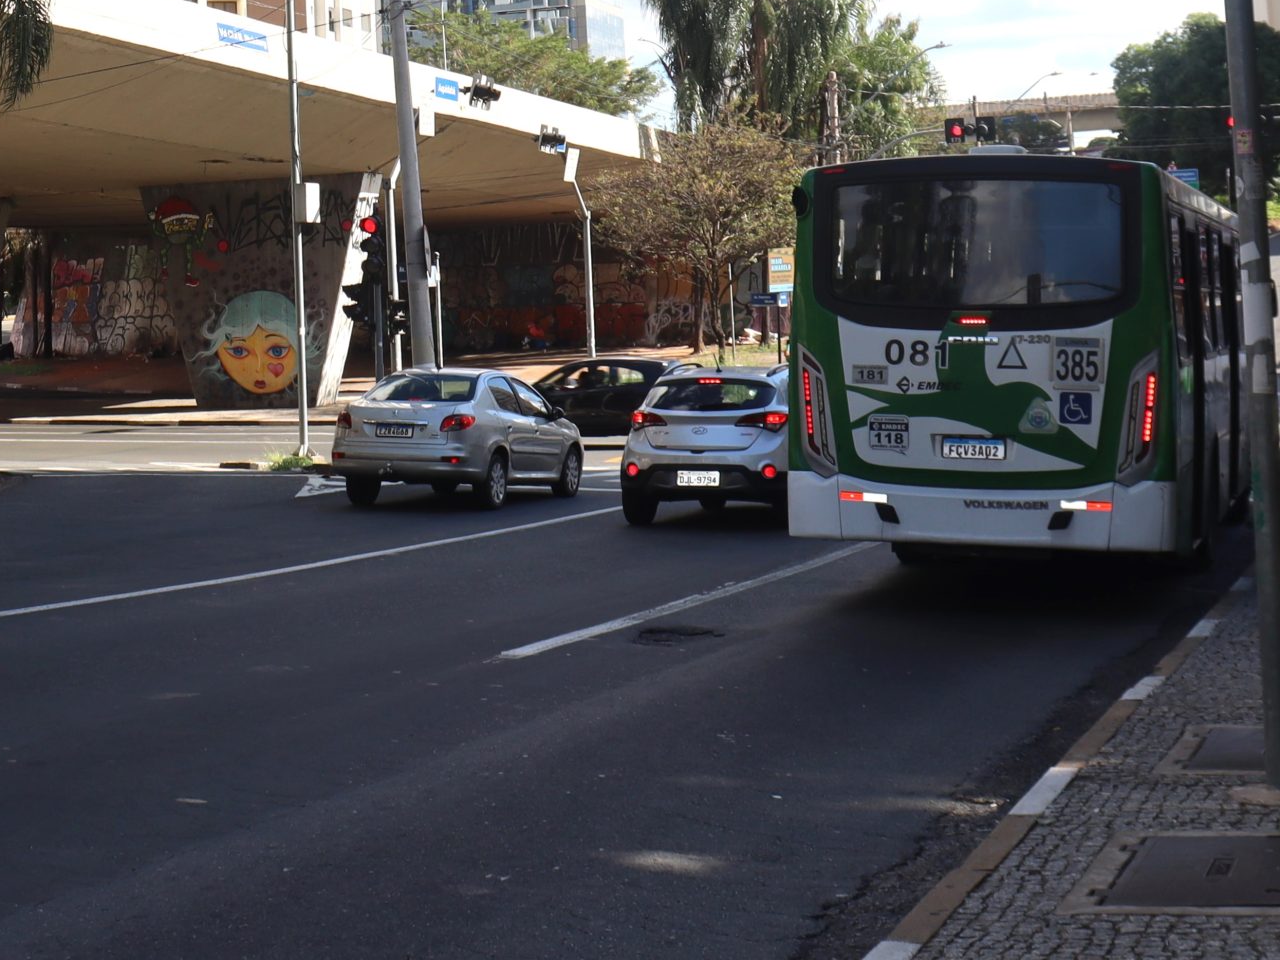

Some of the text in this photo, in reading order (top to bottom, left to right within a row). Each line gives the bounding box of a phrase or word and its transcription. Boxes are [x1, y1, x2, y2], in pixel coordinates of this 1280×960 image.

[884, 339, 949, 369] 081
[1055, 348, 1099, 382] 385
[858, 369, 884, 381] 181
[874, 432, 904, 445] 118
[963, 499, 1049, 510] VOLKSWAGEN
